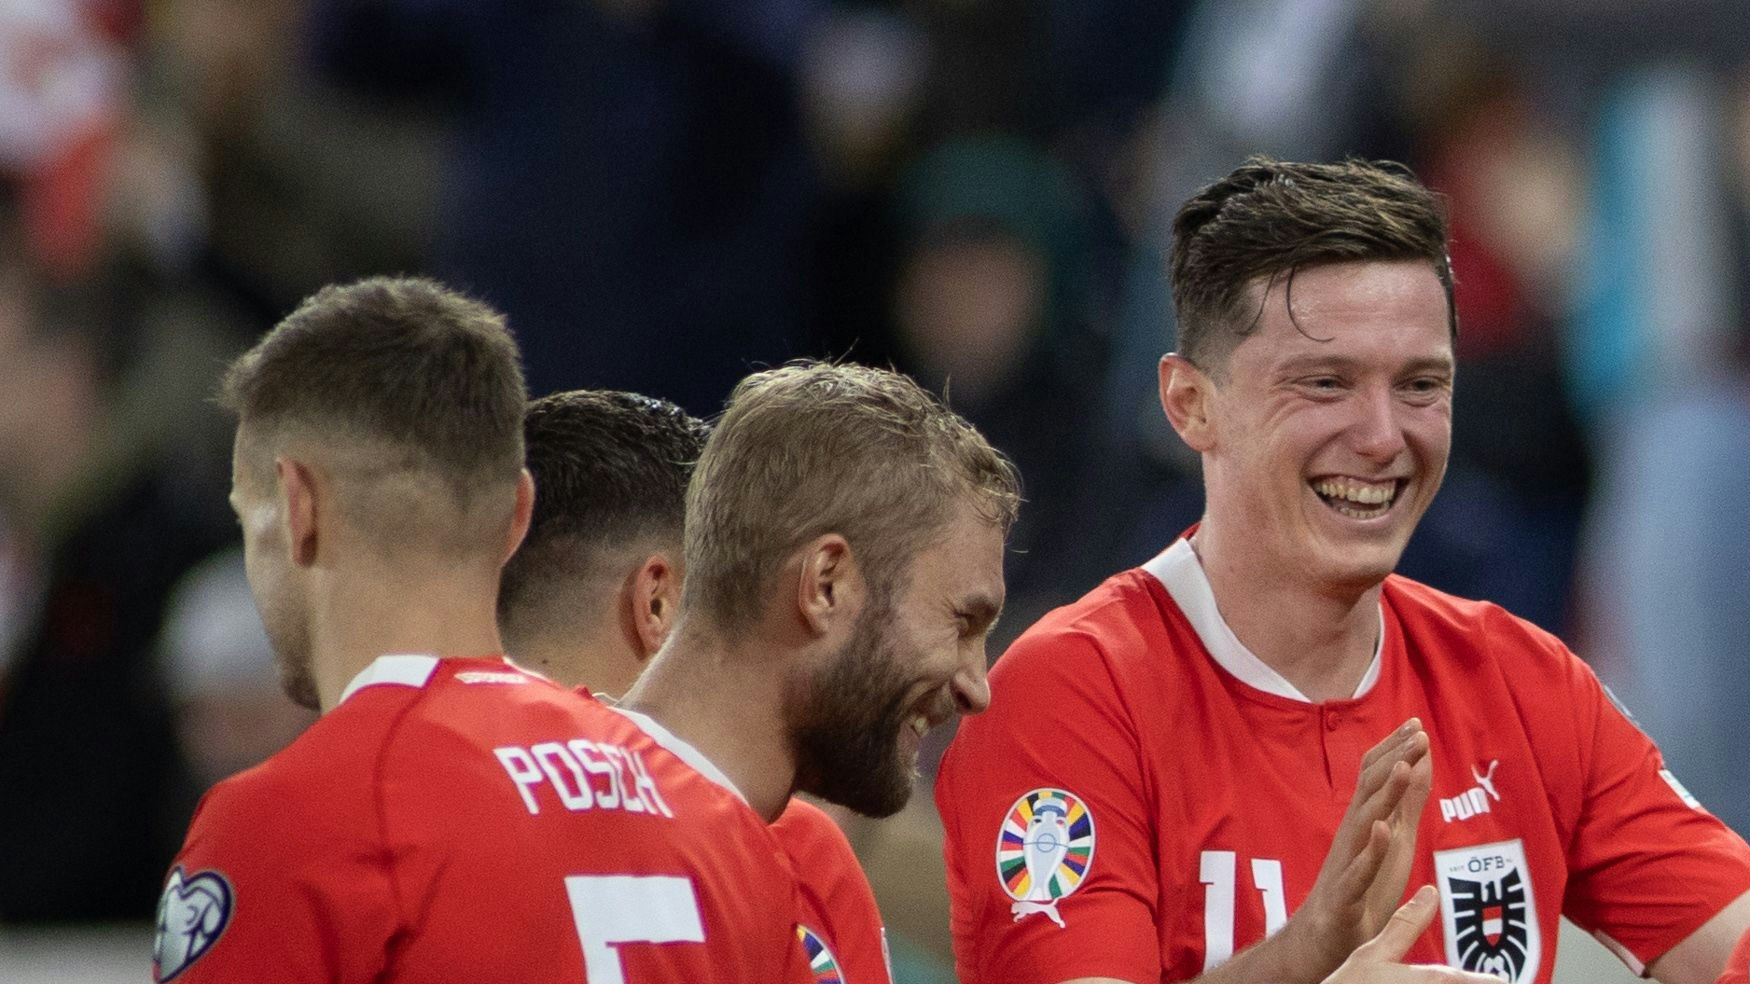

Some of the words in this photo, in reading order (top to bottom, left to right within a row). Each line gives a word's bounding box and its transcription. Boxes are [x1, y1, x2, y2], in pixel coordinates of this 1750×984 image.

[493, 739, 674, 818] POSCH
[1467, 855, 1505, 873] ÖFB
[1199, 850, 1288, 976] 11
